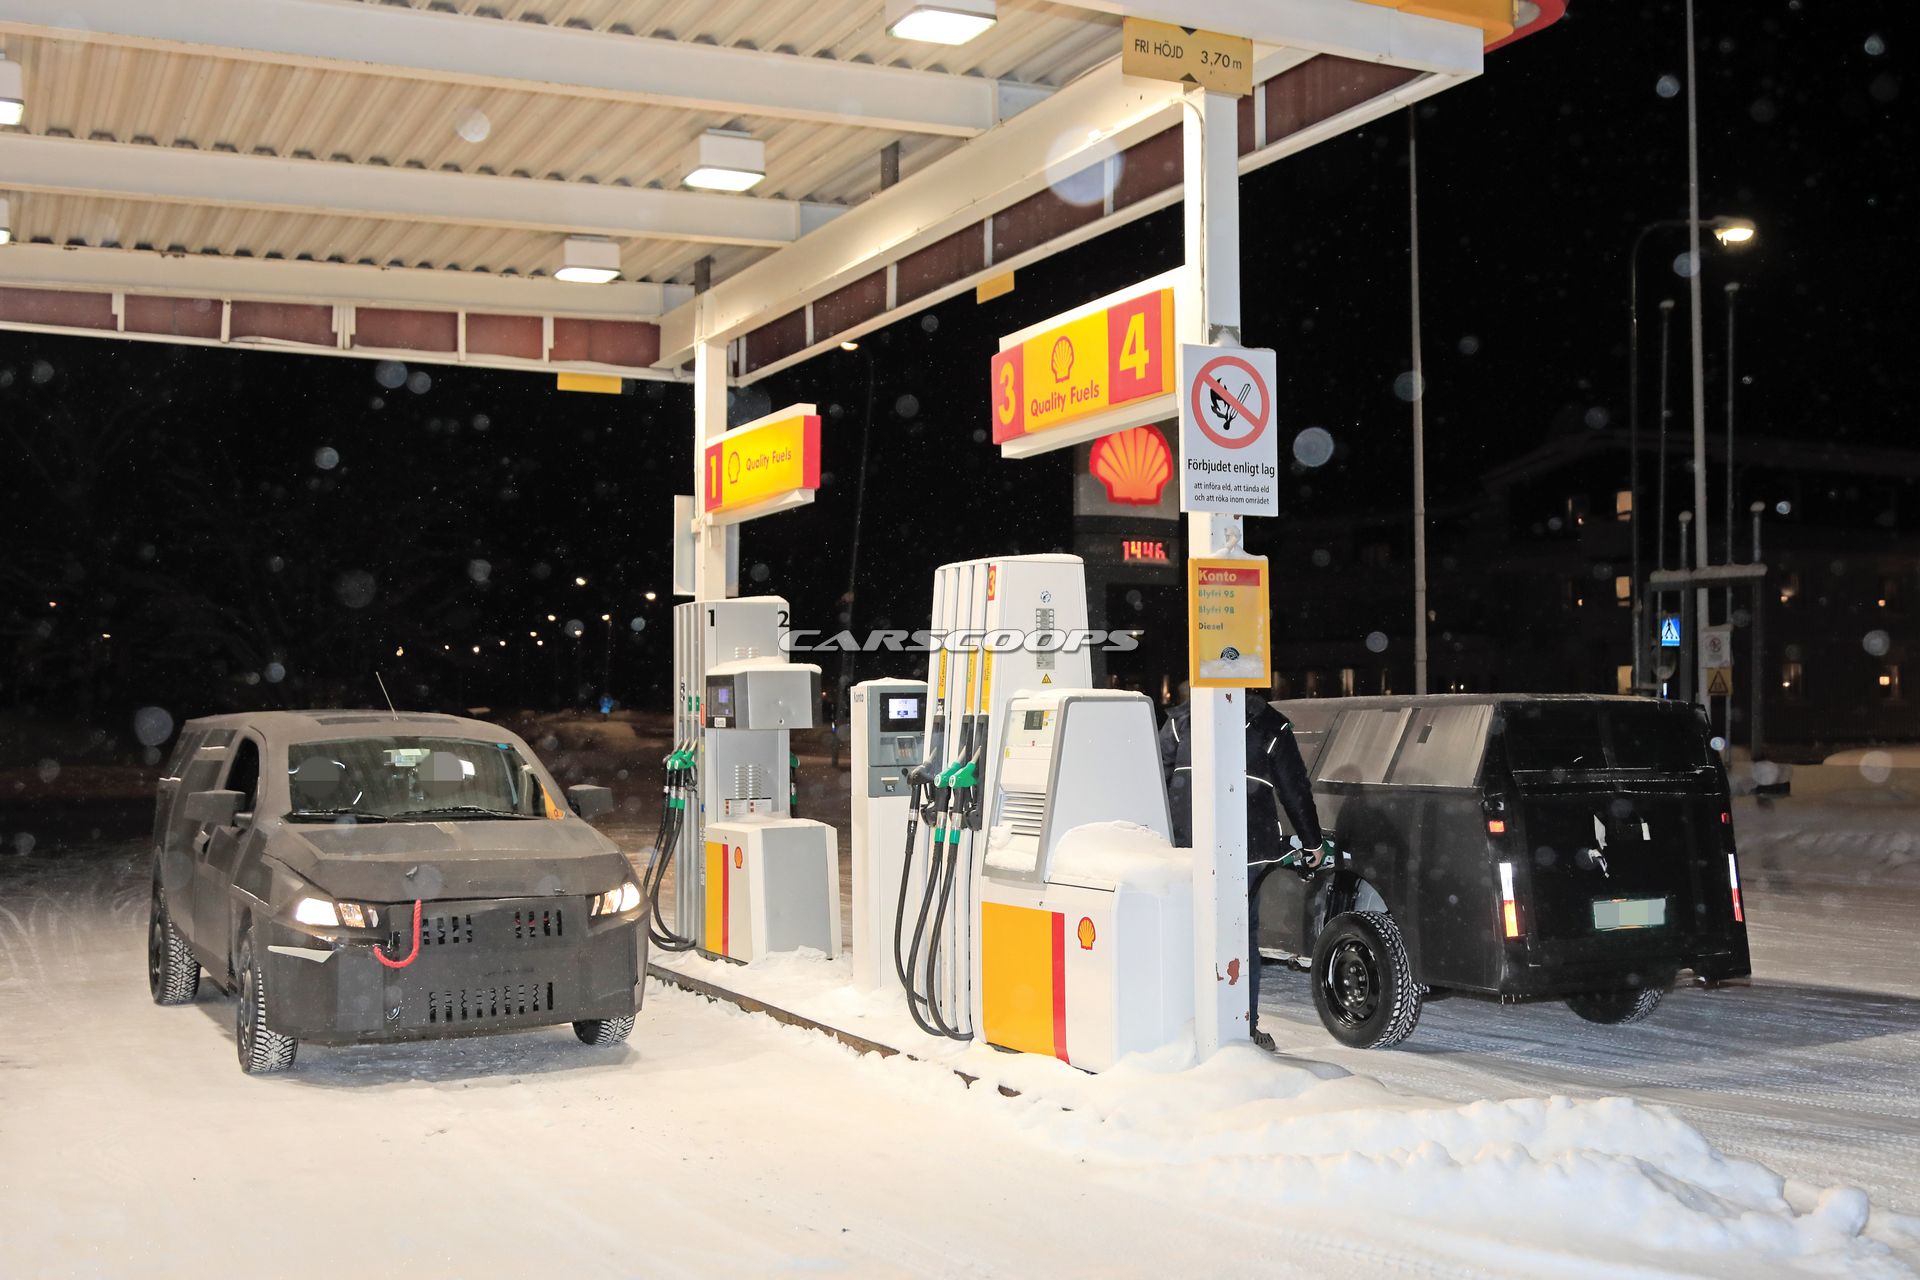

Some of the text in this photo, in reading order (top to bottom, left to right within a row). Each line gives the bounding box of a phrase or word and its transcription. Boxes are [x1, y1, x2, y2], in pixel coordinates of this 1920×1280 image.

[1135, 39, 1242, 70] FRI HÖJD 3,70 m
[1119, 312, 1150, 380] 4
[998, 361, 1016, 425] 3
[1031, 380, 1100, 417] Quality Fuels
[746, 448, 792, 471] Quality Fuels
[1187, 458, 1275, 478] Förbjudet enligt lag
[710, 455, 717, 498] 1
[1194, 481, 1270, 493] att införa eld, att tända eld
[1194, 493, 1205, 501] och
[1215, 494, 1229, 503] röka
[1229, 496, 1245, 504] inom
[1245, 496, 1270, 505] området
[988, 568, 996, 597] 3
[1199, 570, 1237, 582] Konto
[1224, 590, 1235, 598] 95
[708, 609, 715, 627] 1
[777, 610, 790, 627] 2
[1224, 606, 1235, 614] 98
[1198, 622, 1224, 630] Diesel
